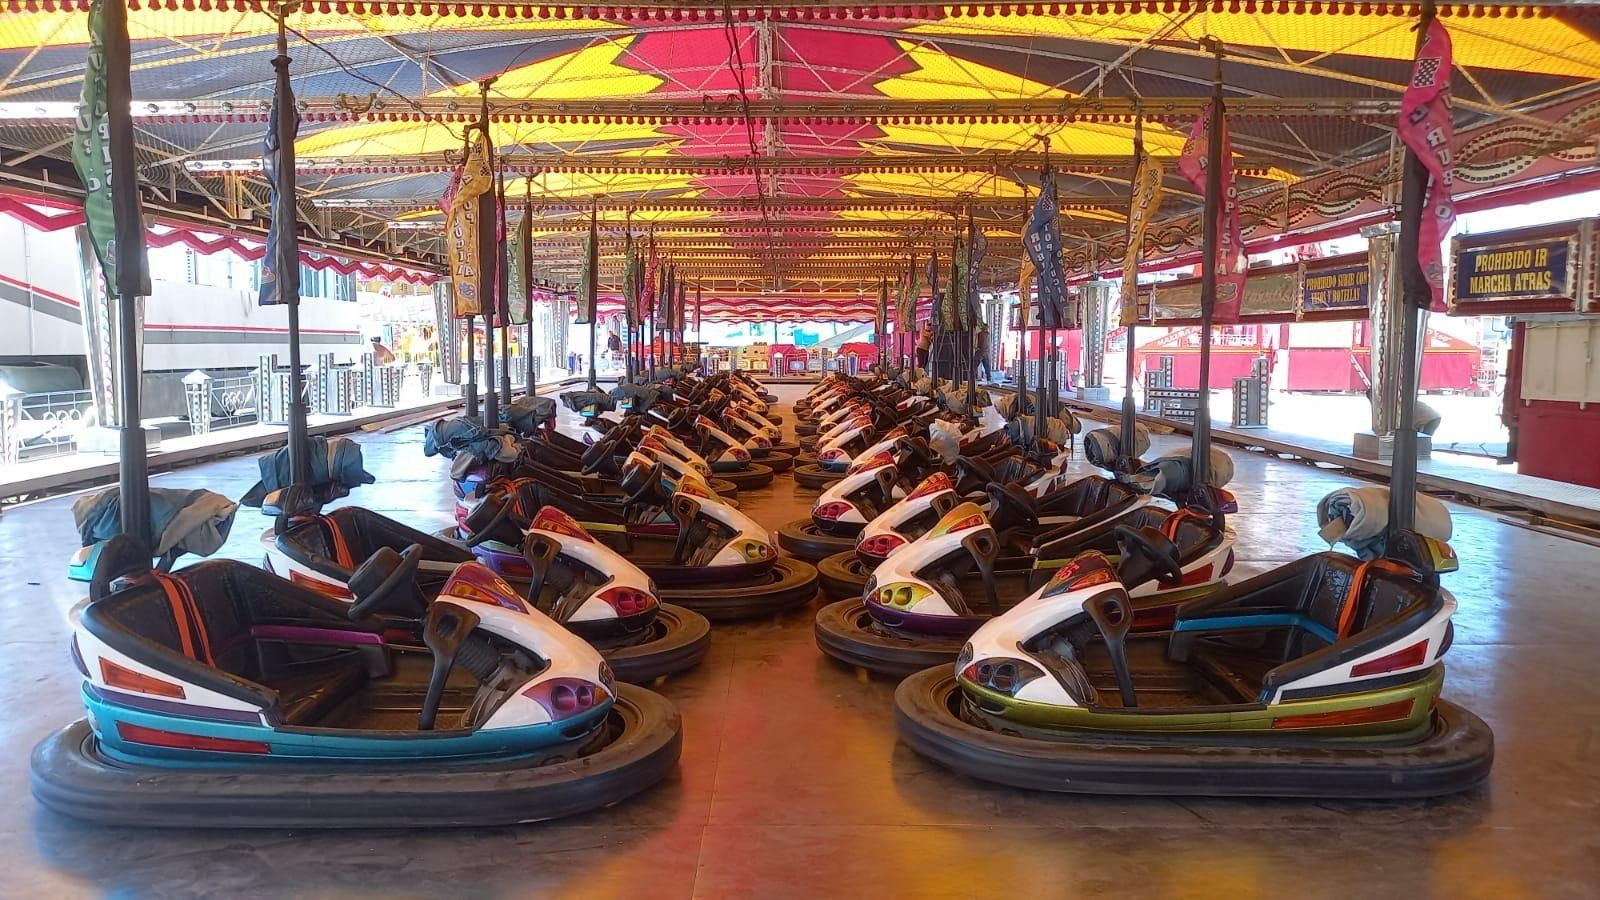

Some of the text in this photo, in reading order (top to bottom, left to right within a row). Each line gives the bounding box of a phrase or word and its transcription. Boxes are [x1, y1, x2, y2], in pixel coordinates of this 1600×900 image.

[1474, 248, 1548, 273] PROHIBIDO IR
[1306, 276, 1336, 289] PROHIBIDO
[1355, 272, 1366, 285] CON
[1470, 271, 1552, 294] MARCHA ATRAS
